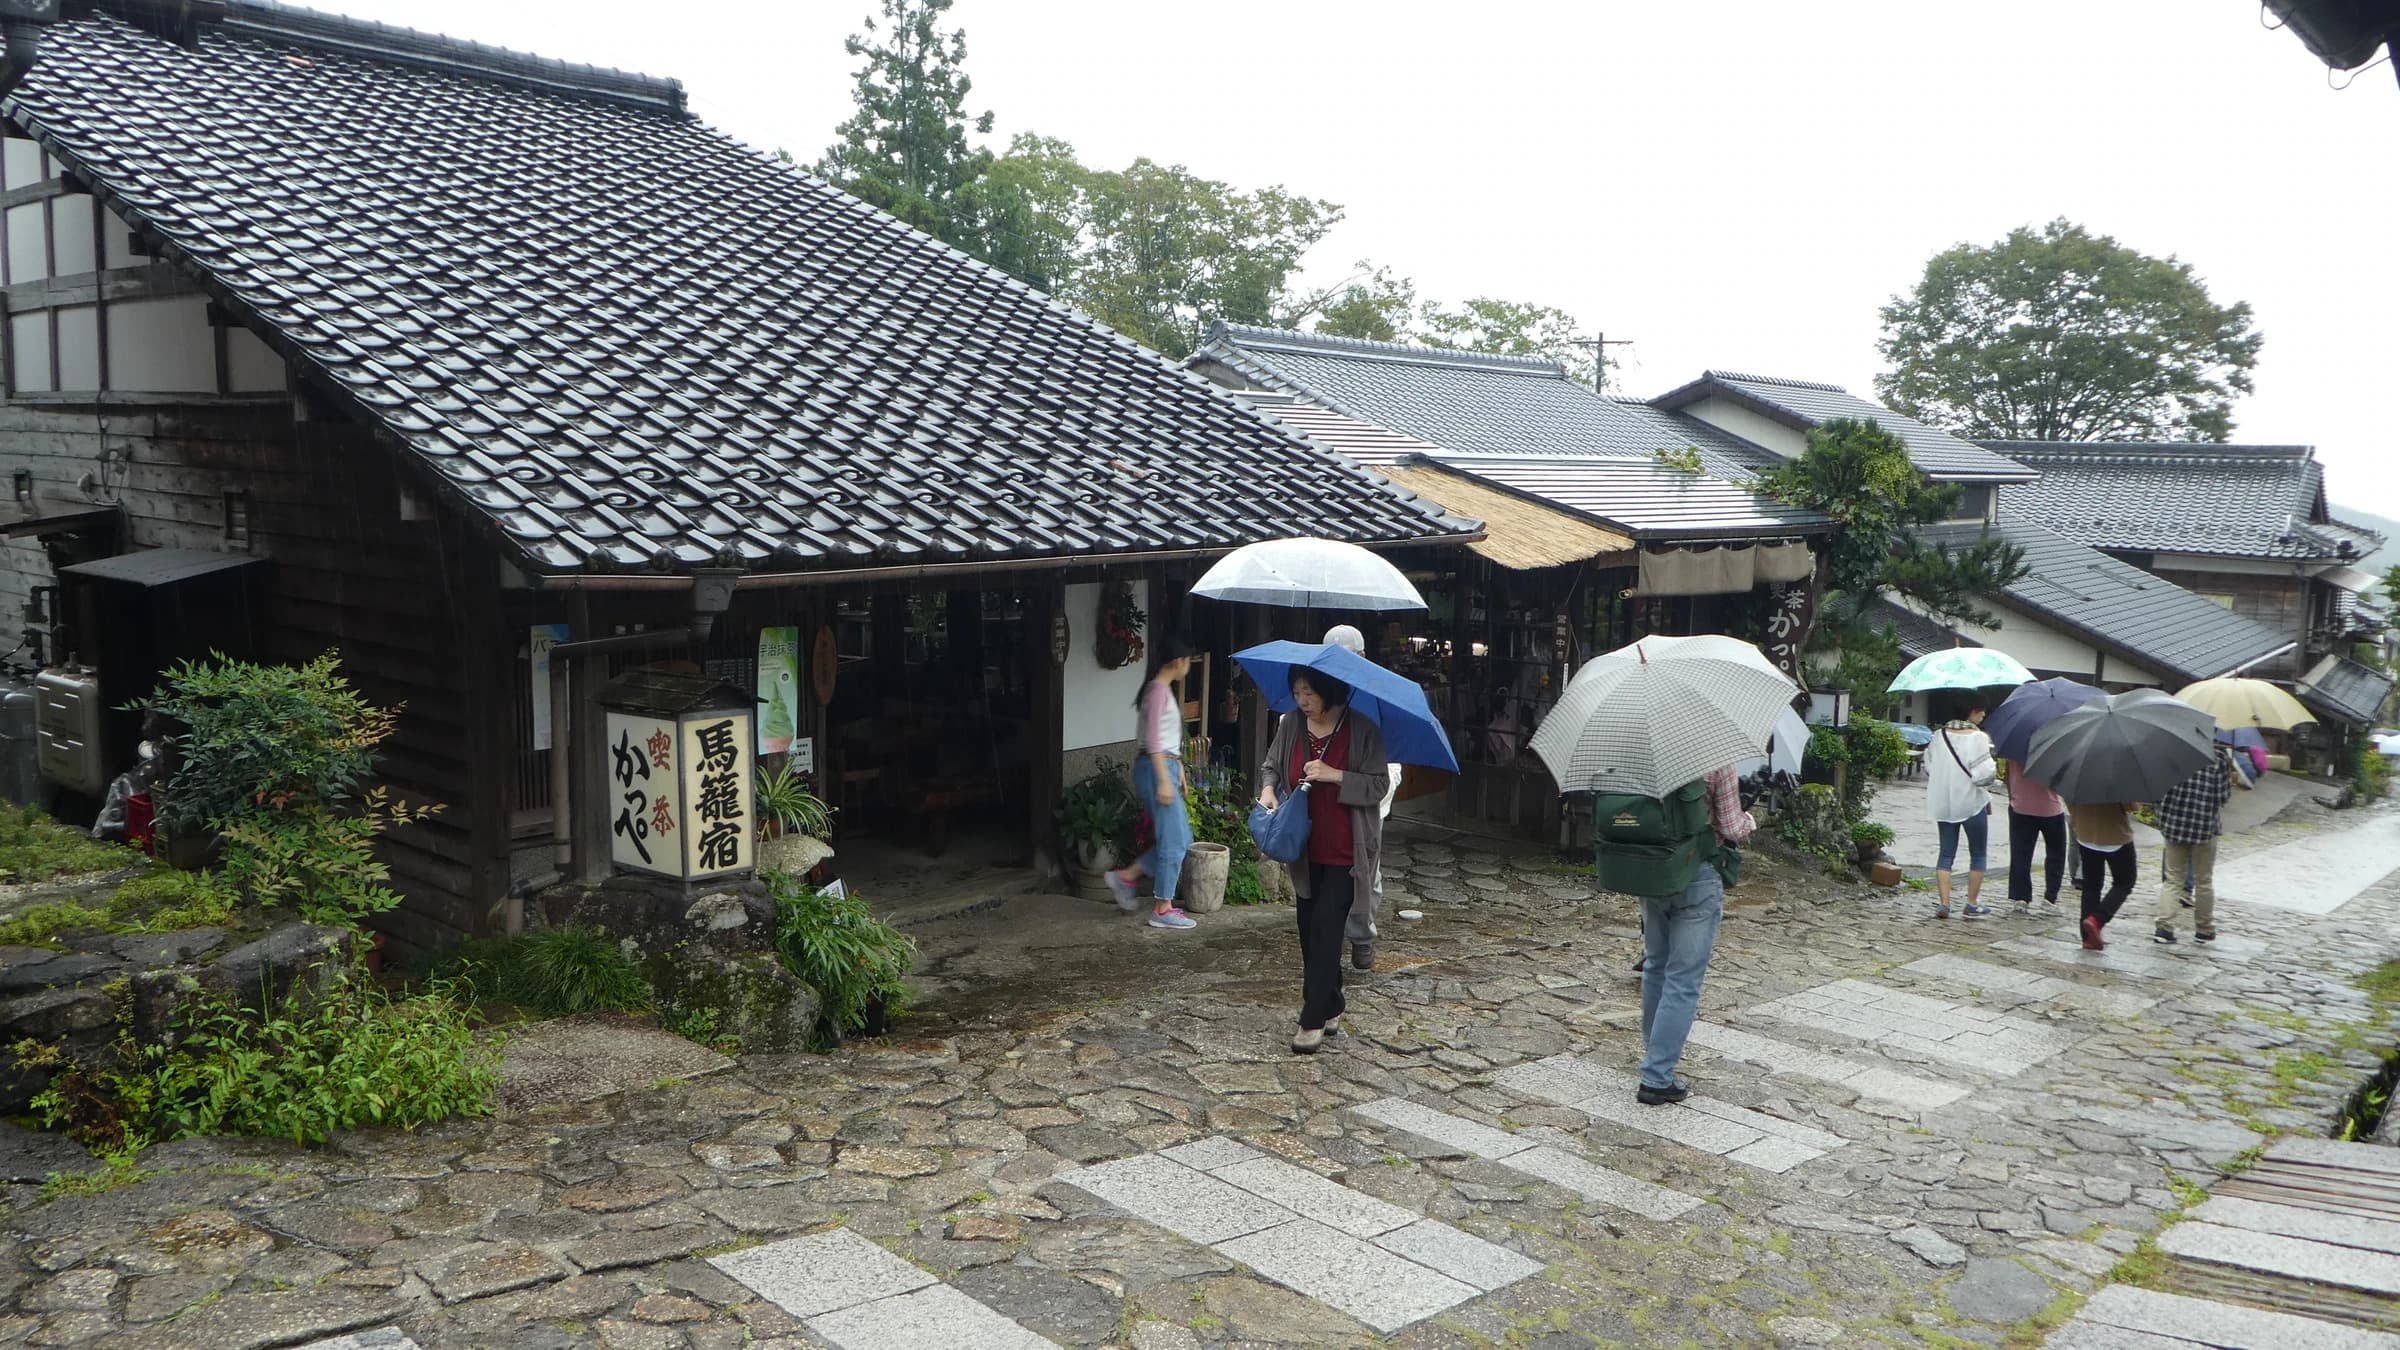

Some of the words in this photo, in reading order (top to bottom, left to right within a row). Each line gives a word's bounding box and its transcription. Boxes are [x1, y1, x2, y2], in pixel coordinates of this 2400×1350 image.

[612, 728, 652, 864] かっぺ
[646, 727, 675, 837] 喫茶
[695, 719, 744, 869] 馬籠宿
